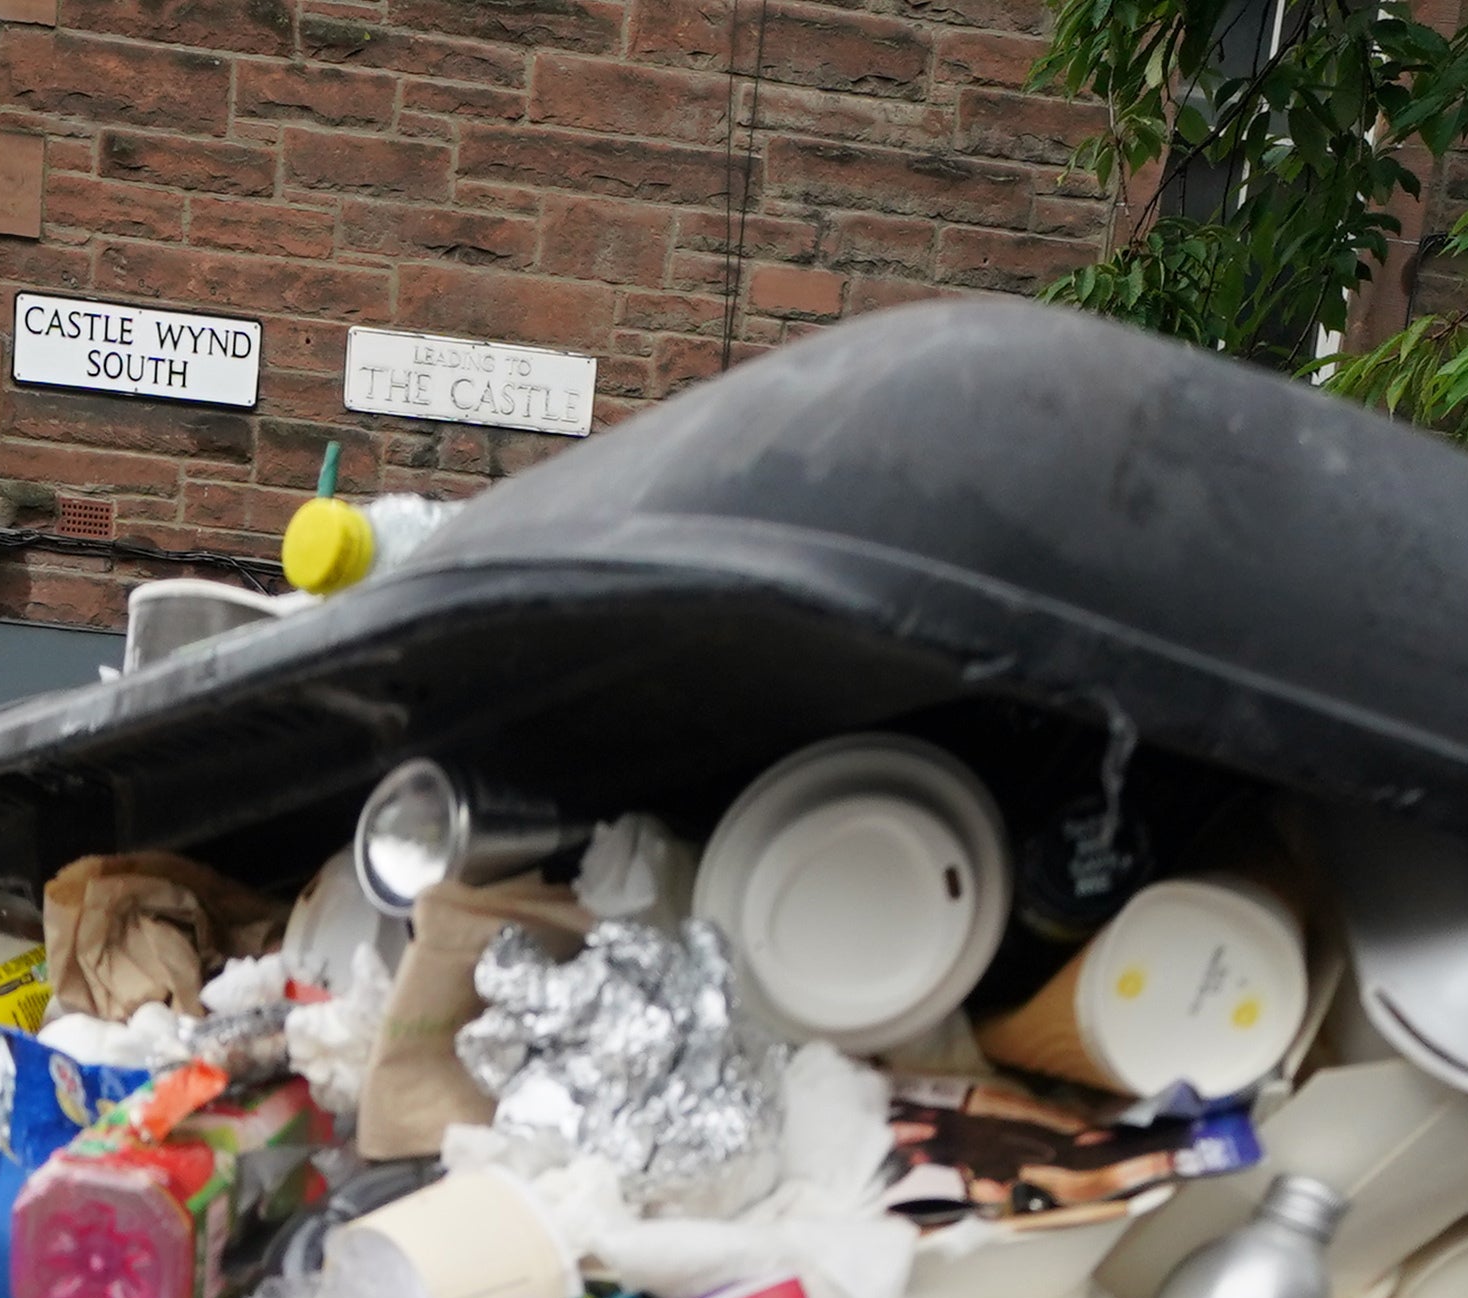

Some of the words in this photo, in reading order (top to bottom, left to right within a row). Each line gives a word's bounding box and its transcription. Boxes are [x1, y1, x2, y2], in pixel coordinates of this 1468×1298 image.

[24, 305, 134, 346] CASTLE
[155, 322, 252, 360] WYND
[85, 350, 189, 389] SOUTH
[413, 344, 495, 375] LEADING
[505, 356, 532, 377] TO
[359, 366, 432, 406] THE
[448, 378, 582, 425] CASTLE
